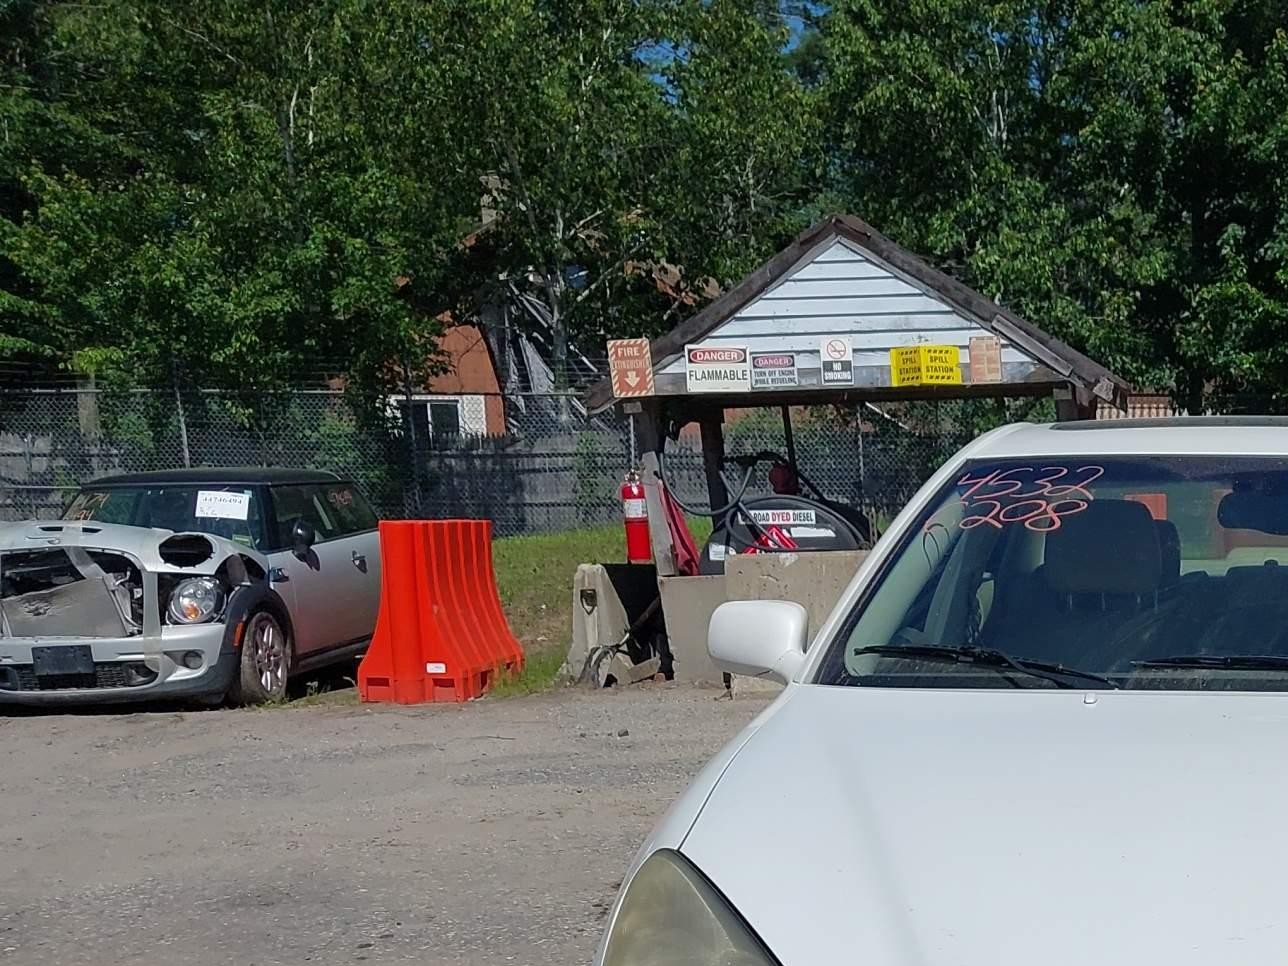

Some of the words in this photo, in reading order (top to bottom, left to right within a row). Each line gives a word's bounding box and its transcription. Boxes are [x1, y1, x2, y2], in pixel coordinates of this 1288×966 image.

[617, 346, 640, 357] FIRE
[696, 351, 738, 361] DANGER
[758, 358, 789, 366] DANGER
[902, 357, 916, 365] SPILL
[929, 355, 949, 364] SPILL
[832, 362, 842, 371] NO
[689, 369, 748, 381] FLAMMABLE
[824, 371, 852, 380] SMOKING
[957, 465, 1105, 501] 4532
[753, 512, 770, 522] ROAD
[771, 512, 791, 522] DYED
[792, 512, 813, 522] DIESEL
